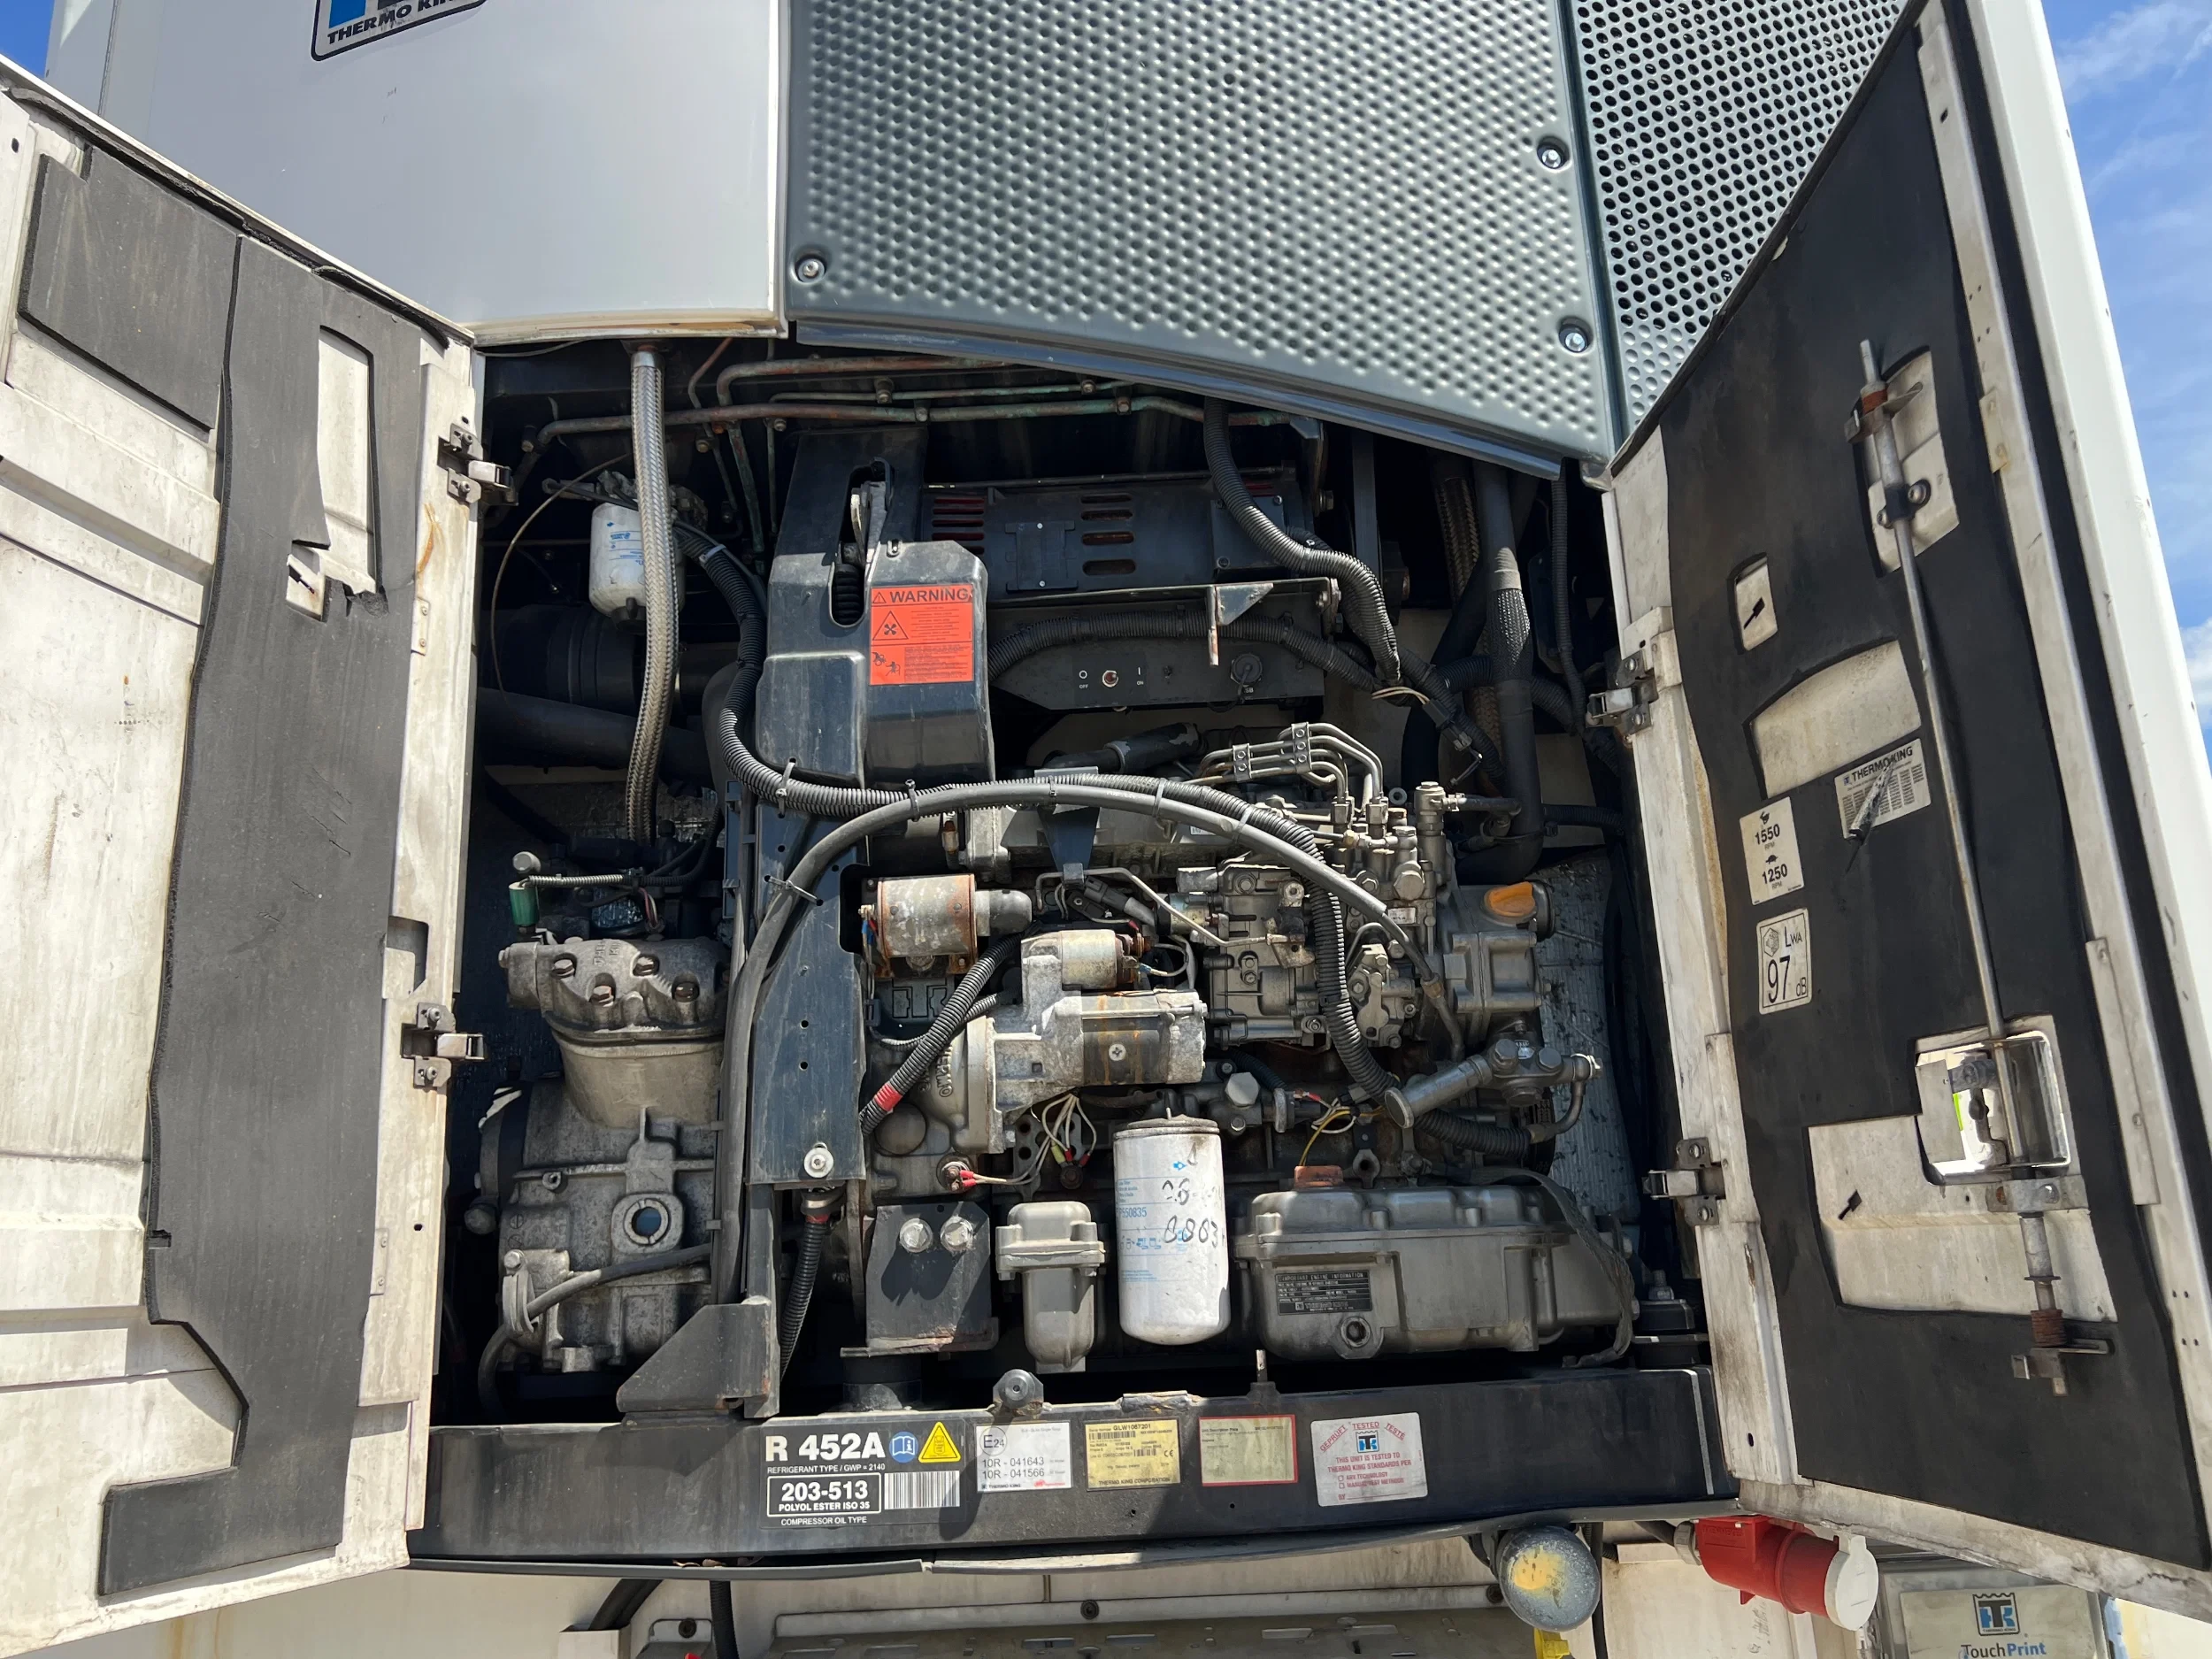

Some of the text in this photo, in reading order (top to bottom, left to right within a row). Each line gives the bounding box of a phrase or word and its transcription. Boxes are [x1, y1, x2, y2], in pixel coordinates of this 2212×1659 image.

[327, 4, 411, 44] THERMO
[890, 588, 969, 603] WARNING
[1755, 823, 1780, 845] 1550
[1762, 863, 1788, 885] 1250
[1768, 954, 1791, 1003] 97
[1795, 976, 1807, 997] dB
[1352, 1421, 1379, 1430] TESTED
[765, 1432, 886, 1462] R 452A
[767, 1465, 818, 1474] REFRIGERANT
[982, 1458, 1001, 1468] 10R
[1010, 1456, 1045, 1467] 041643
[982, 1469, 1002, 1479] 10R
[1010, 1468, 1045, 1478] 041566
[781, 1479, 868, 1502] 203-513
[779, 1503, 811, 1512] POLYOL
[859, 1501, 871, 1509] 35
[780, 1517, 833, 1525] COMPRESSOR
[1961, 1642, 2047, 1659] TouchPrint
